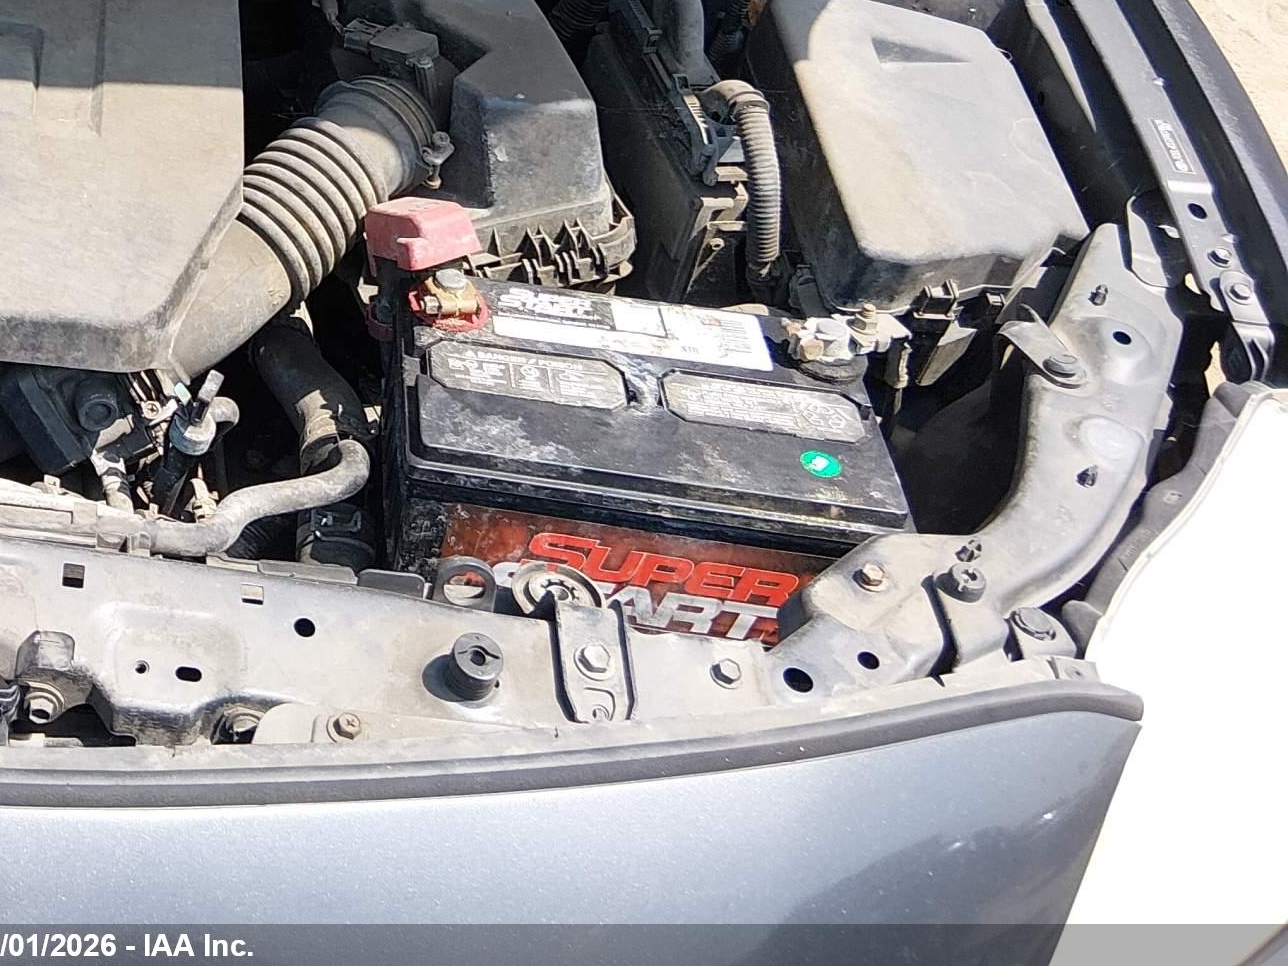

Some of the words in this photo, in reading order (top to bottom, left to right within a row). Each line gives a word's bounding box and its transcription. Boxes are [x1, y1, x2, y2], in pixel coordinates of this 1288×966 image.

[477, 351, 526, 365] DANGER
[537, 359, 584, 371] POISON
[528, 532, 800, 608] SUPER
